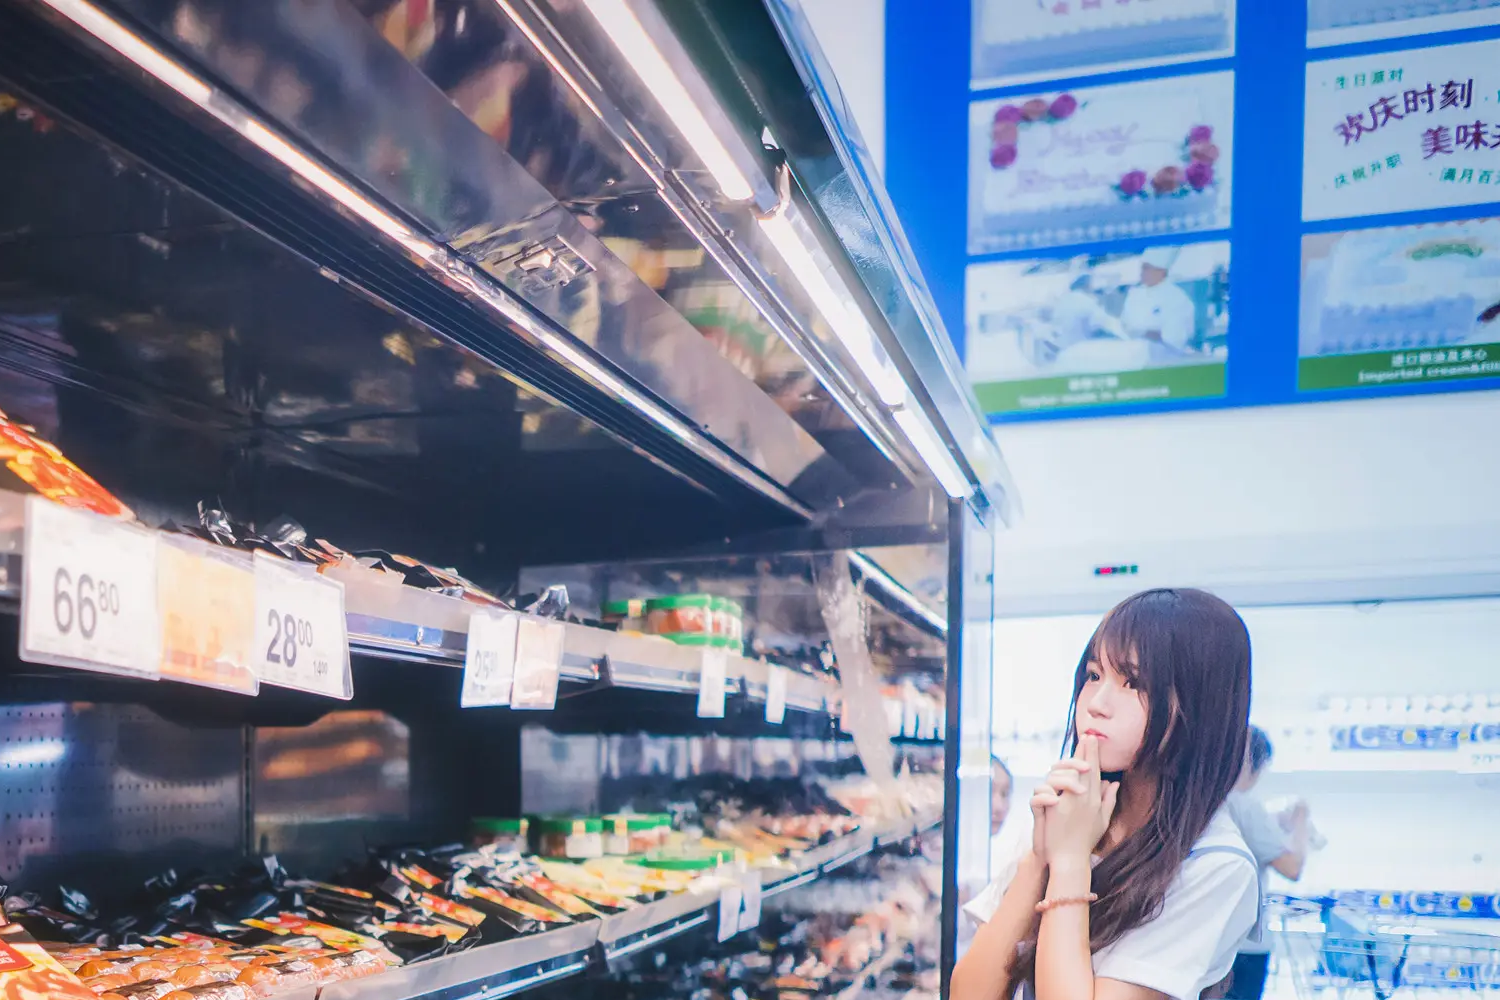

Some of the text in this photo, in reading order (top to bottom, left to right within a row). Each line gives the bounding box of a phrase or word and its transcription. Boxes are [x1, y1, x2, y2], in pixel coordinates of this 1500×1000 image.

[1333, 78, 1474, 147] 欢庆时刻
[1438, 167, 1500, 186] 满月百
